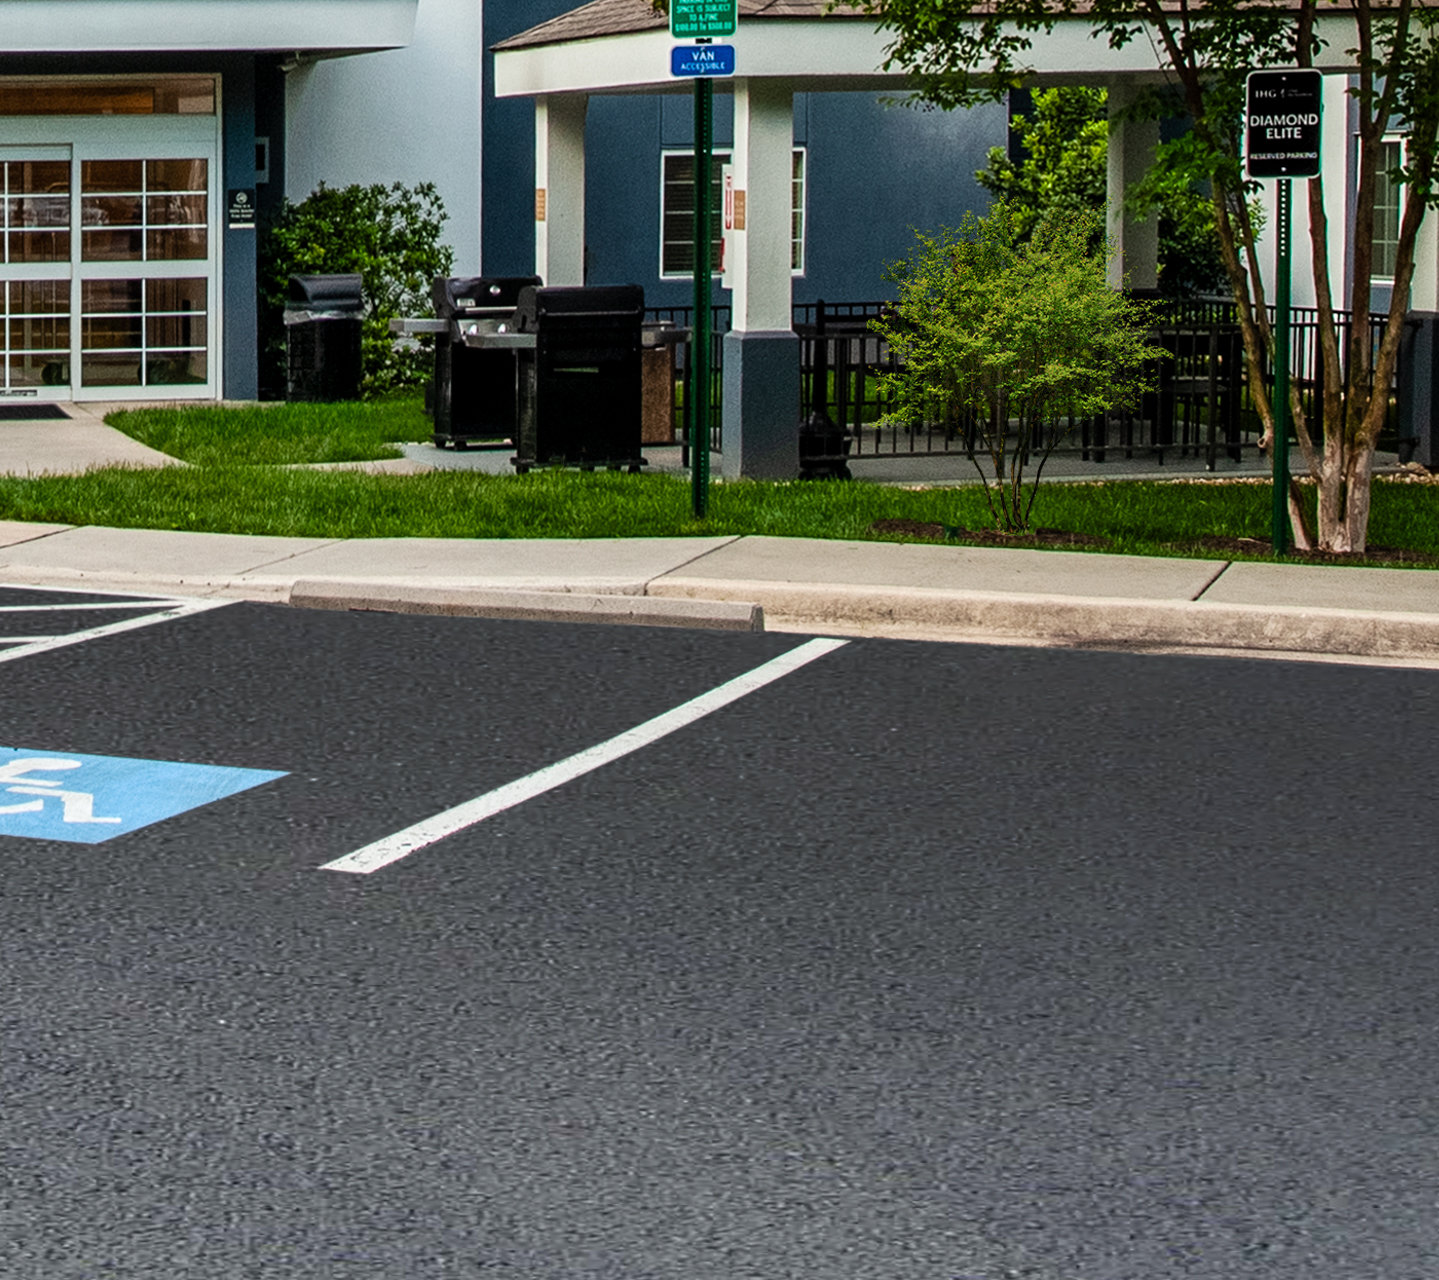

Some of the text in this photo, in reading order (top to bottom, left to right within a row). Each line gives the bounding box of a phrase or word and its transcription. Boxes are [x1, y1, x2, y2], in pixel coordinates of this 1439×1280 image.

[692, 51, 715, 61] VAN
[681, 61, 725, 71] ACCESSIBLE
[1255, 89, 1277, 98] IHG
[1250, 113, 1319, 127] DIAMOND
[1266, 127, 1302, 139] ELITE
[1250, 151, 1318, 160] RESERVED PARKING
